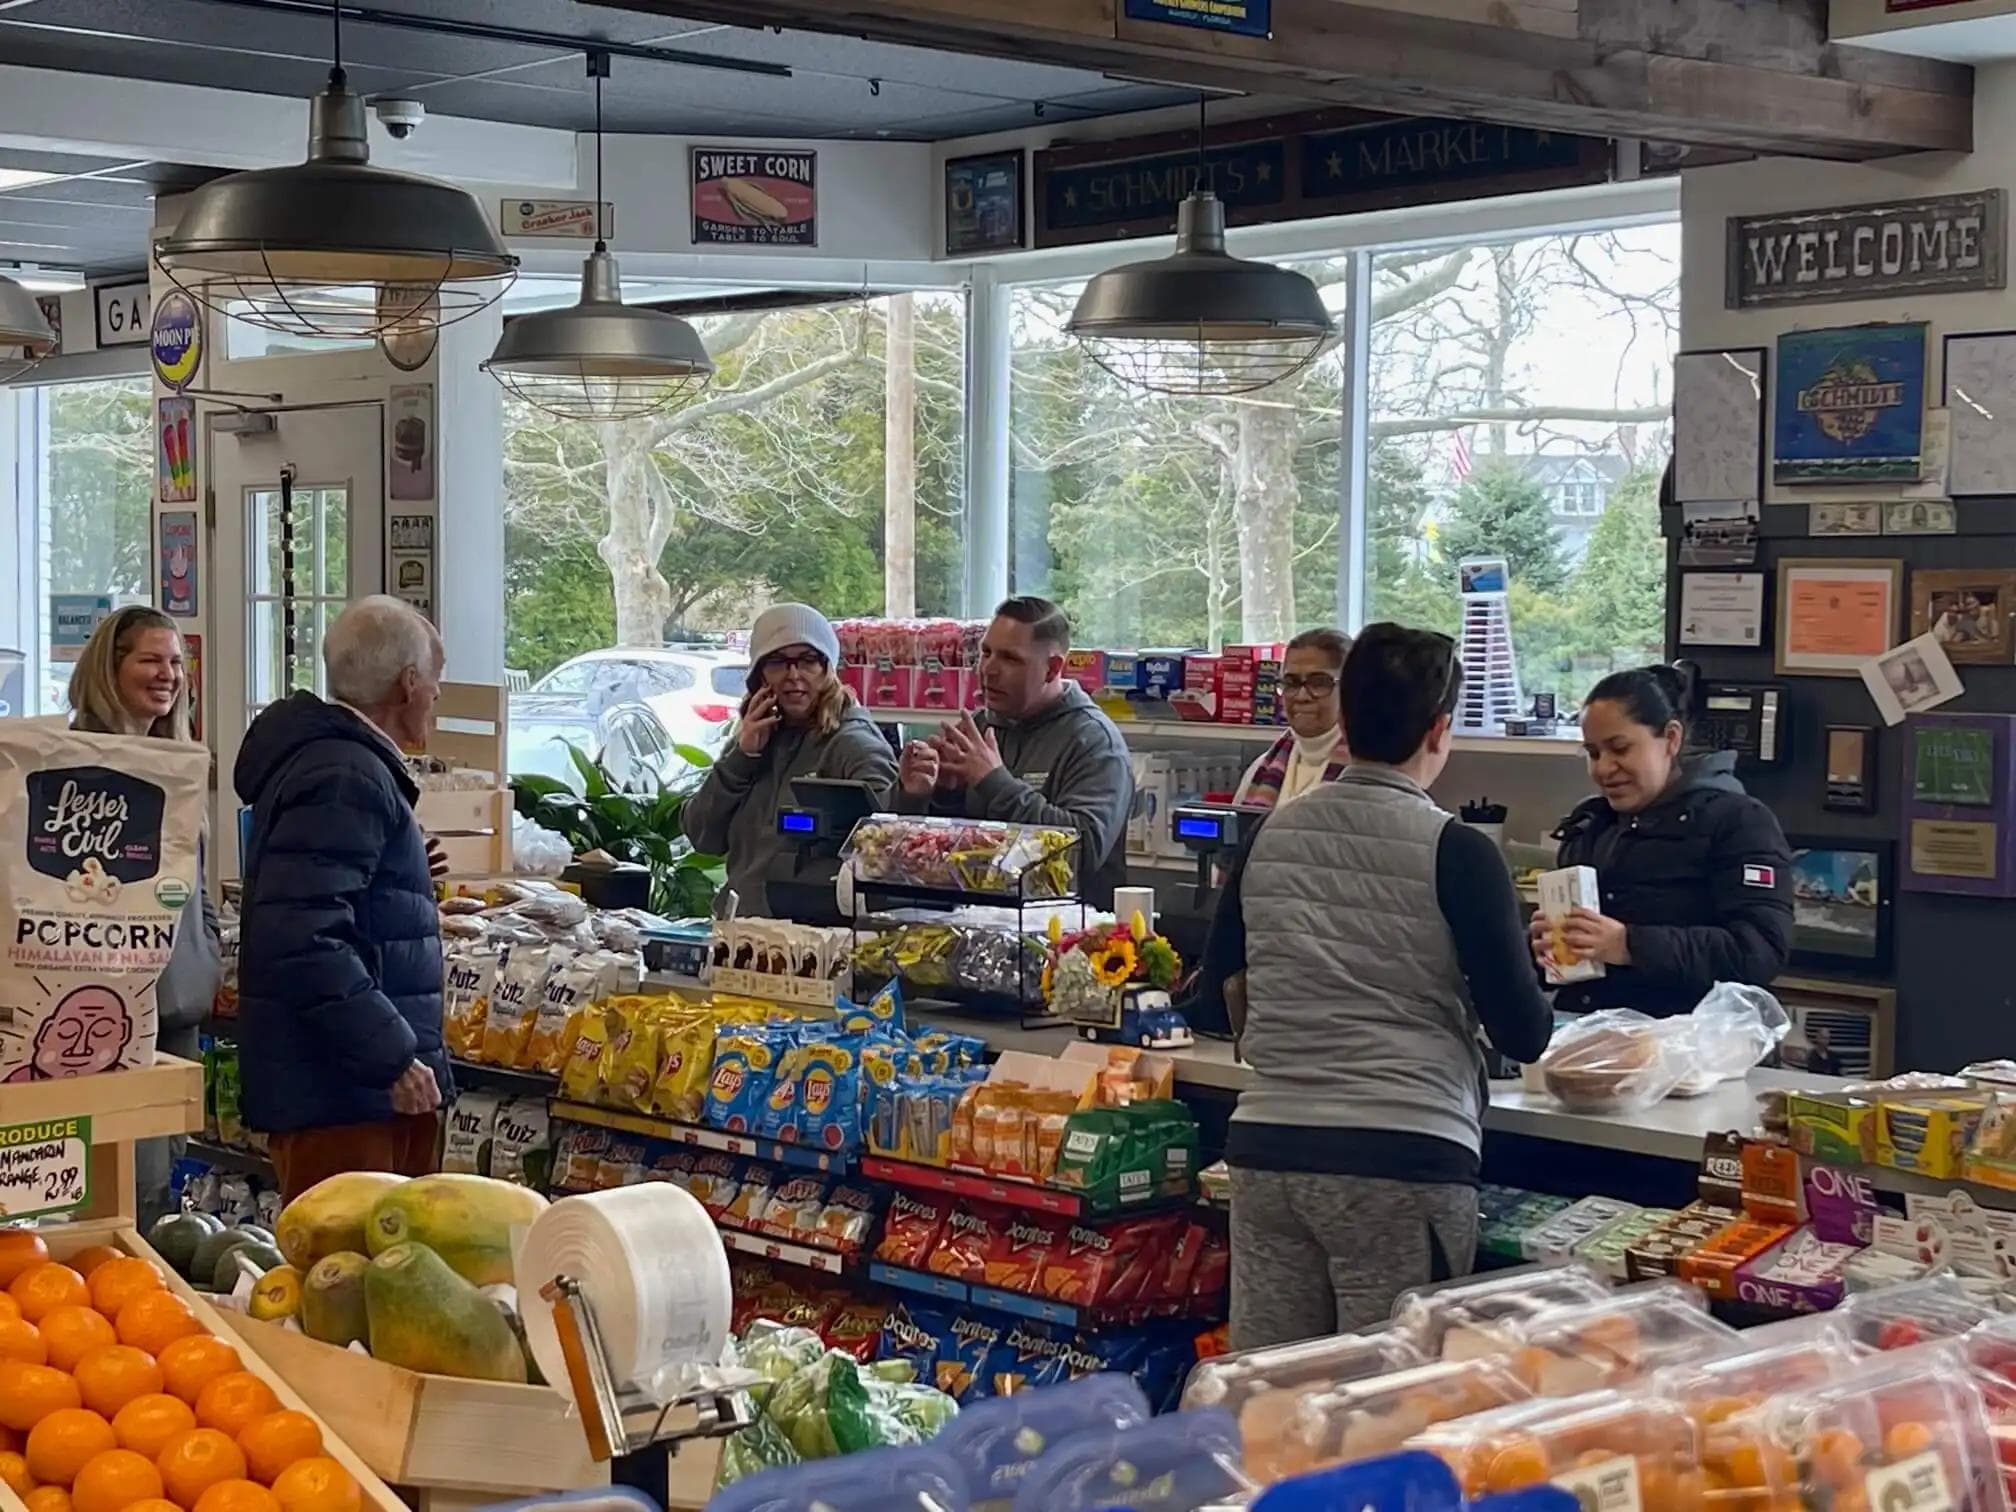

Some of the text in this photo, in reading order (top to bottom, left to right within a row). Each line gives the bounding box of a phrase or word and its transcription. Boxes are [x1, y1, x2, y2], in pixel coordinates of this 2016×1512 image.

[1357, 125, 1511, 176] MARKET
[700, 155, 810, 181] SWEET CORN
[702, 221, 746, 234] GARDEN
[712, 232, 746, 241] TABLE
[752, 234, 766, 242] TO
[1748, 217, 1981, 285] WELCOME
[153, 326, 200, 347] MOON PIE
[44, 780, 129, 831] Lesser
[61, 812, 120, 860] Evil
[16, 918, 175, 949] POPCORN
[8, 947, 103, 963] HIMALAYAN
[37, 963, 71, 972] ORGANIC
[1811, 1167, 1877, 1207] ONE
[1739, 1281, 1792, 1307] ONE
[884, 1312, 940, 1350] Doritos
[951, 1317, 1000, 1343] Doritos
[1006, 1329, 1058, 1355] Doritos
